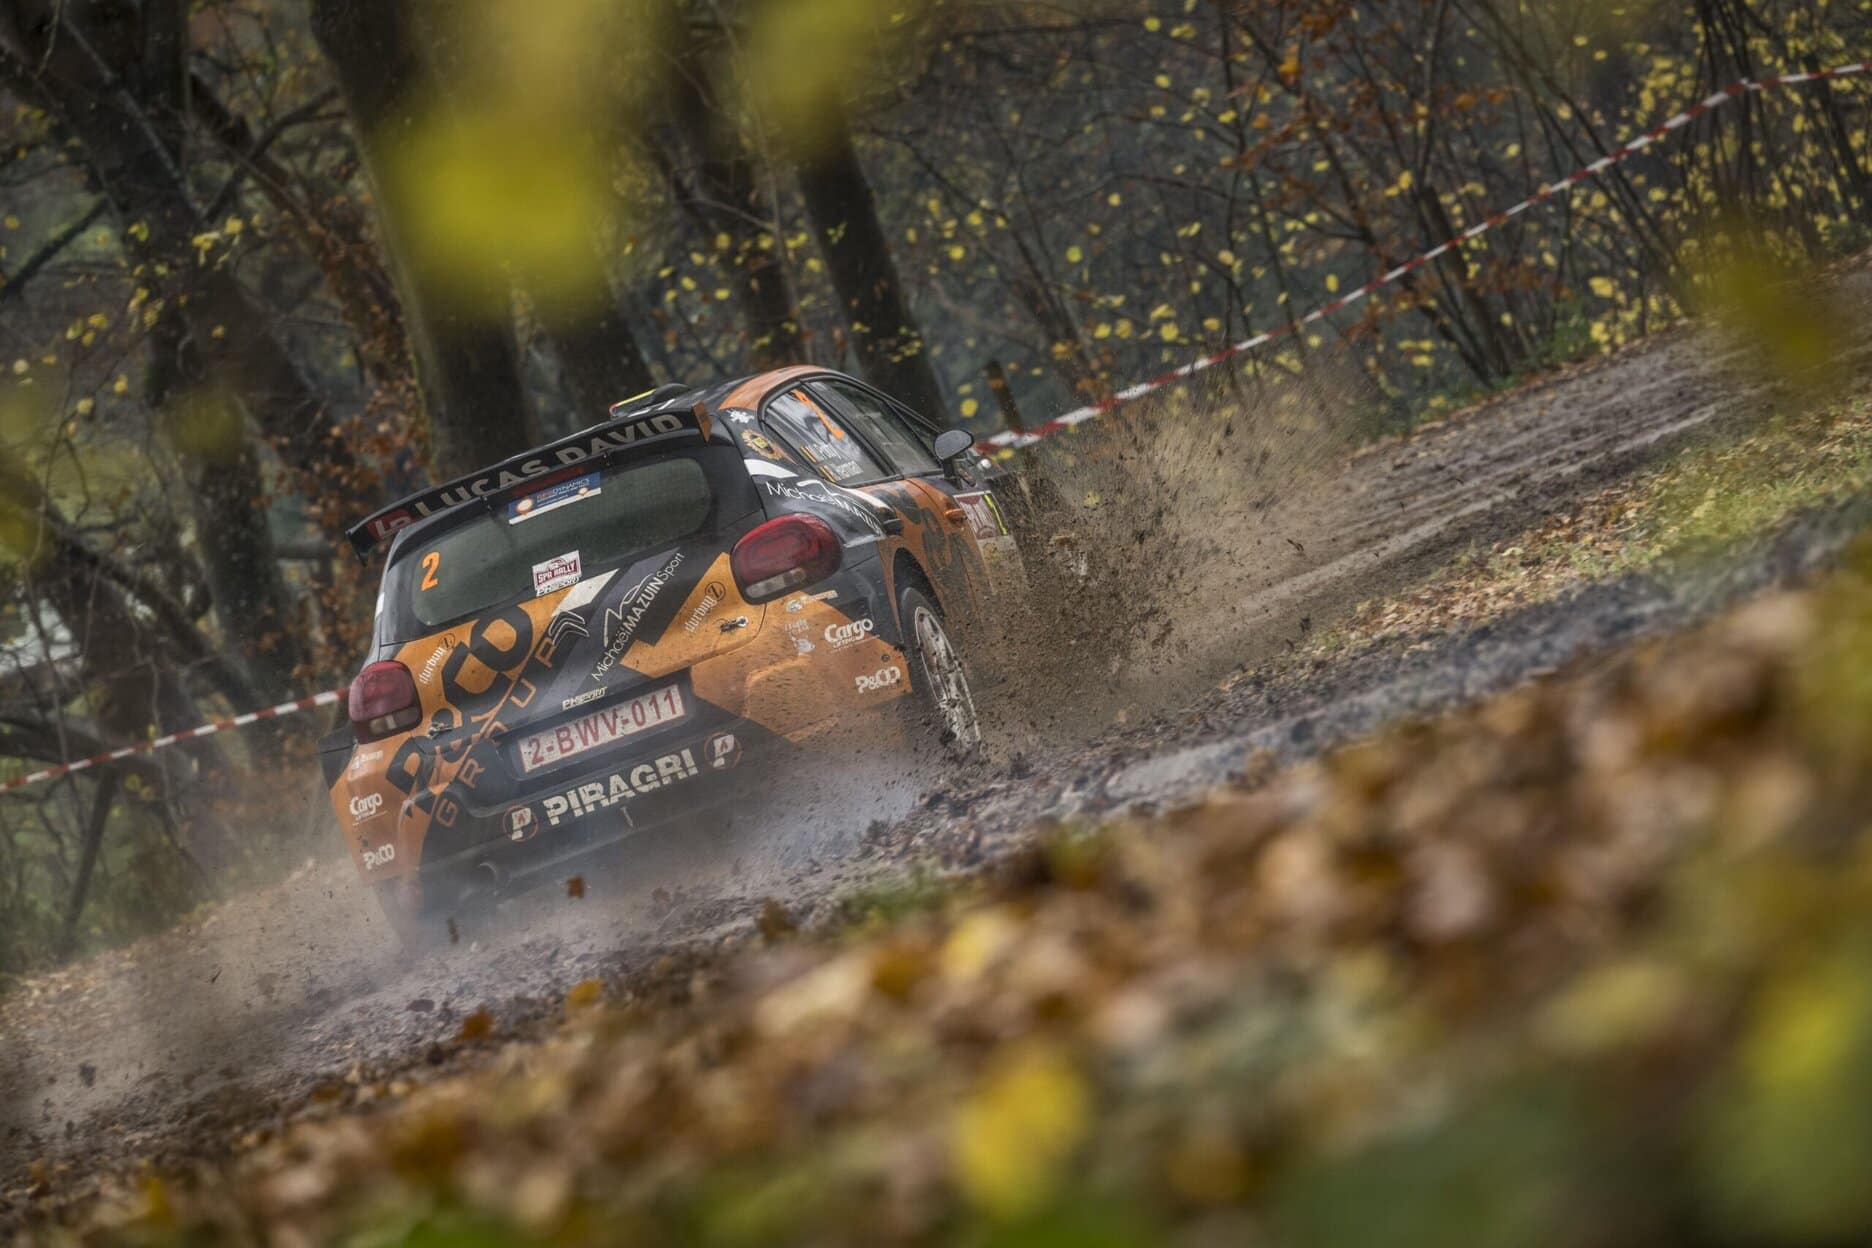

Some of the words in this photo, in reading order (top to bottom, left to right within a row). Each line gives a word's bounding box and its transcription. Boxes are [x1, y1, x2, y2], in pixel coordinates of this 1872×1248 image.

[415, 459, 550, 517] LUCAS
[555, 413, 683, 465] DAVID
[421, 551, 441, 592] 2
[823, 617, 874, 644] Cargo
[527, 689, 678, 766] 2-BWV-011
[349, 792, 383, 816] Cargo
[543, 747, 700, 827] PIRAGRI
